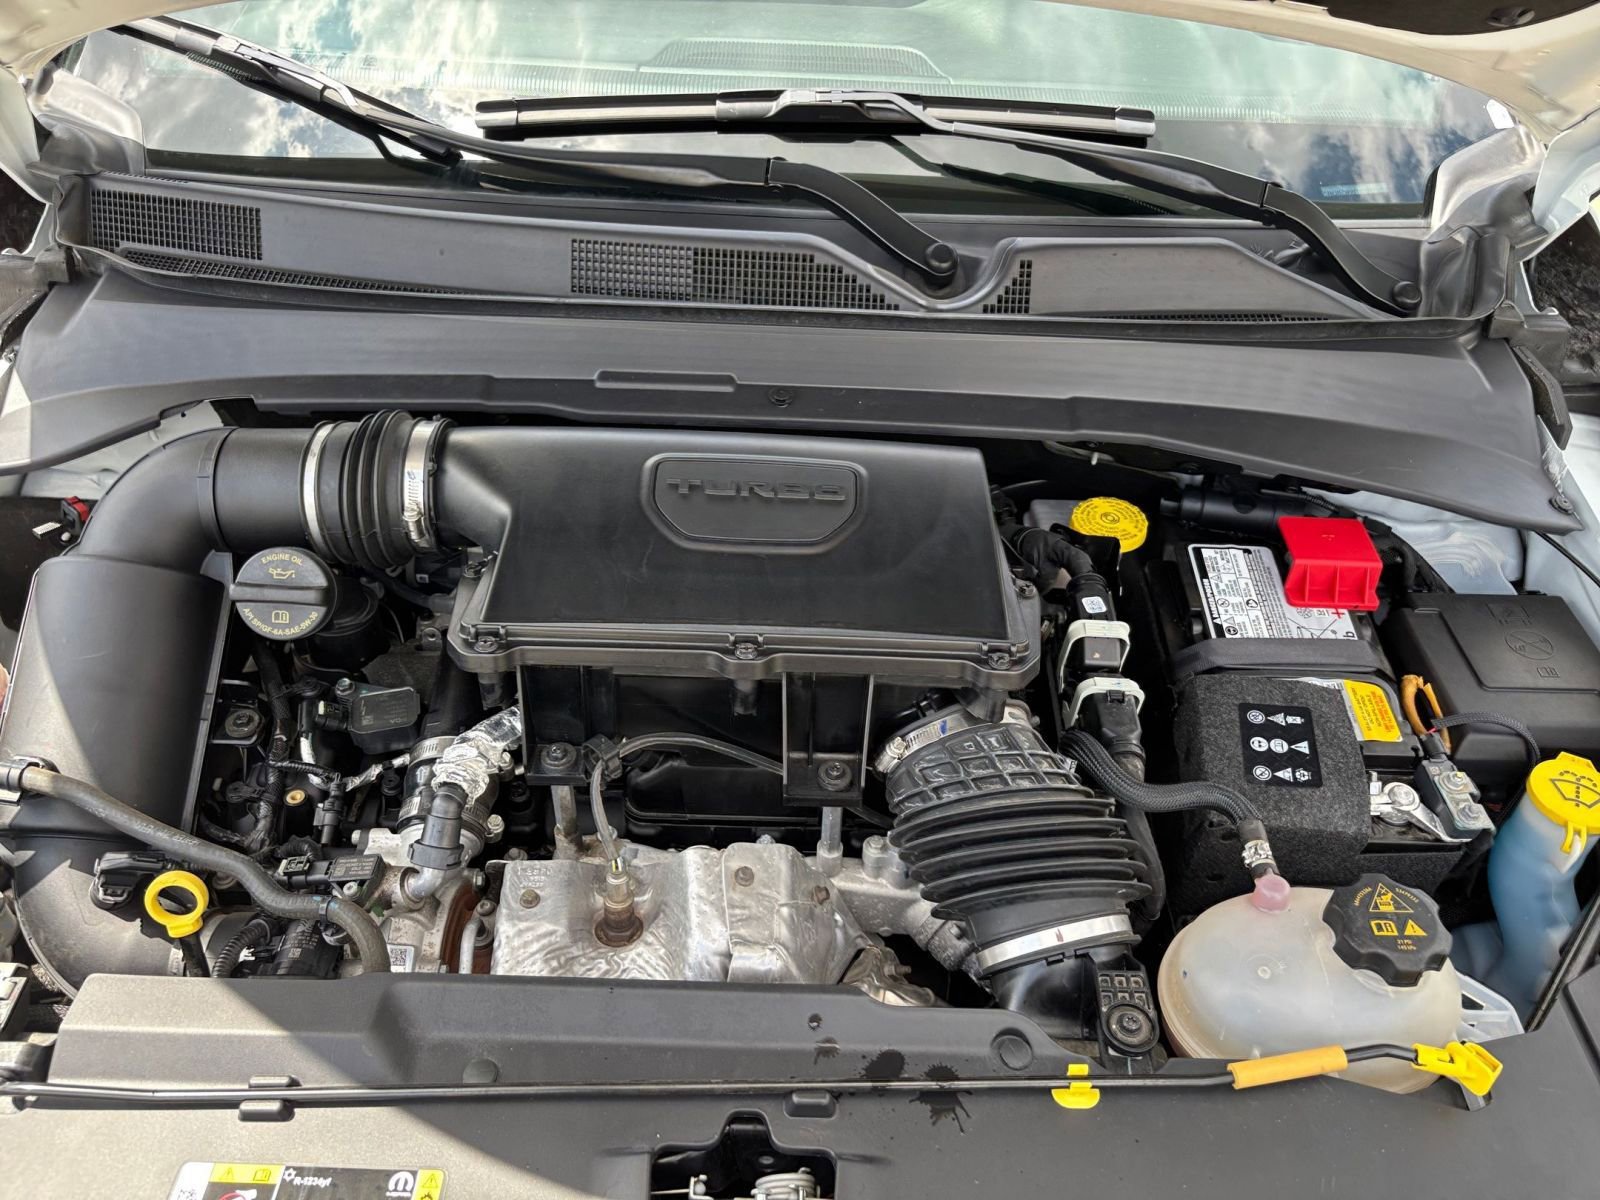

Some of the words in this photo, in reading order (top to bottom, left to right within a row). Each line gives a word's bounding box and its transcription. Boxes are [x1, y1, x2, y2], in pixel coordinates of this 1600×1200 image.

[666, 478, 846, 501] TURBO
[261, 553, 290, 564] ENGINE
[291, 556, 302, 565] OIL
[243, 608, 254, 620] API
